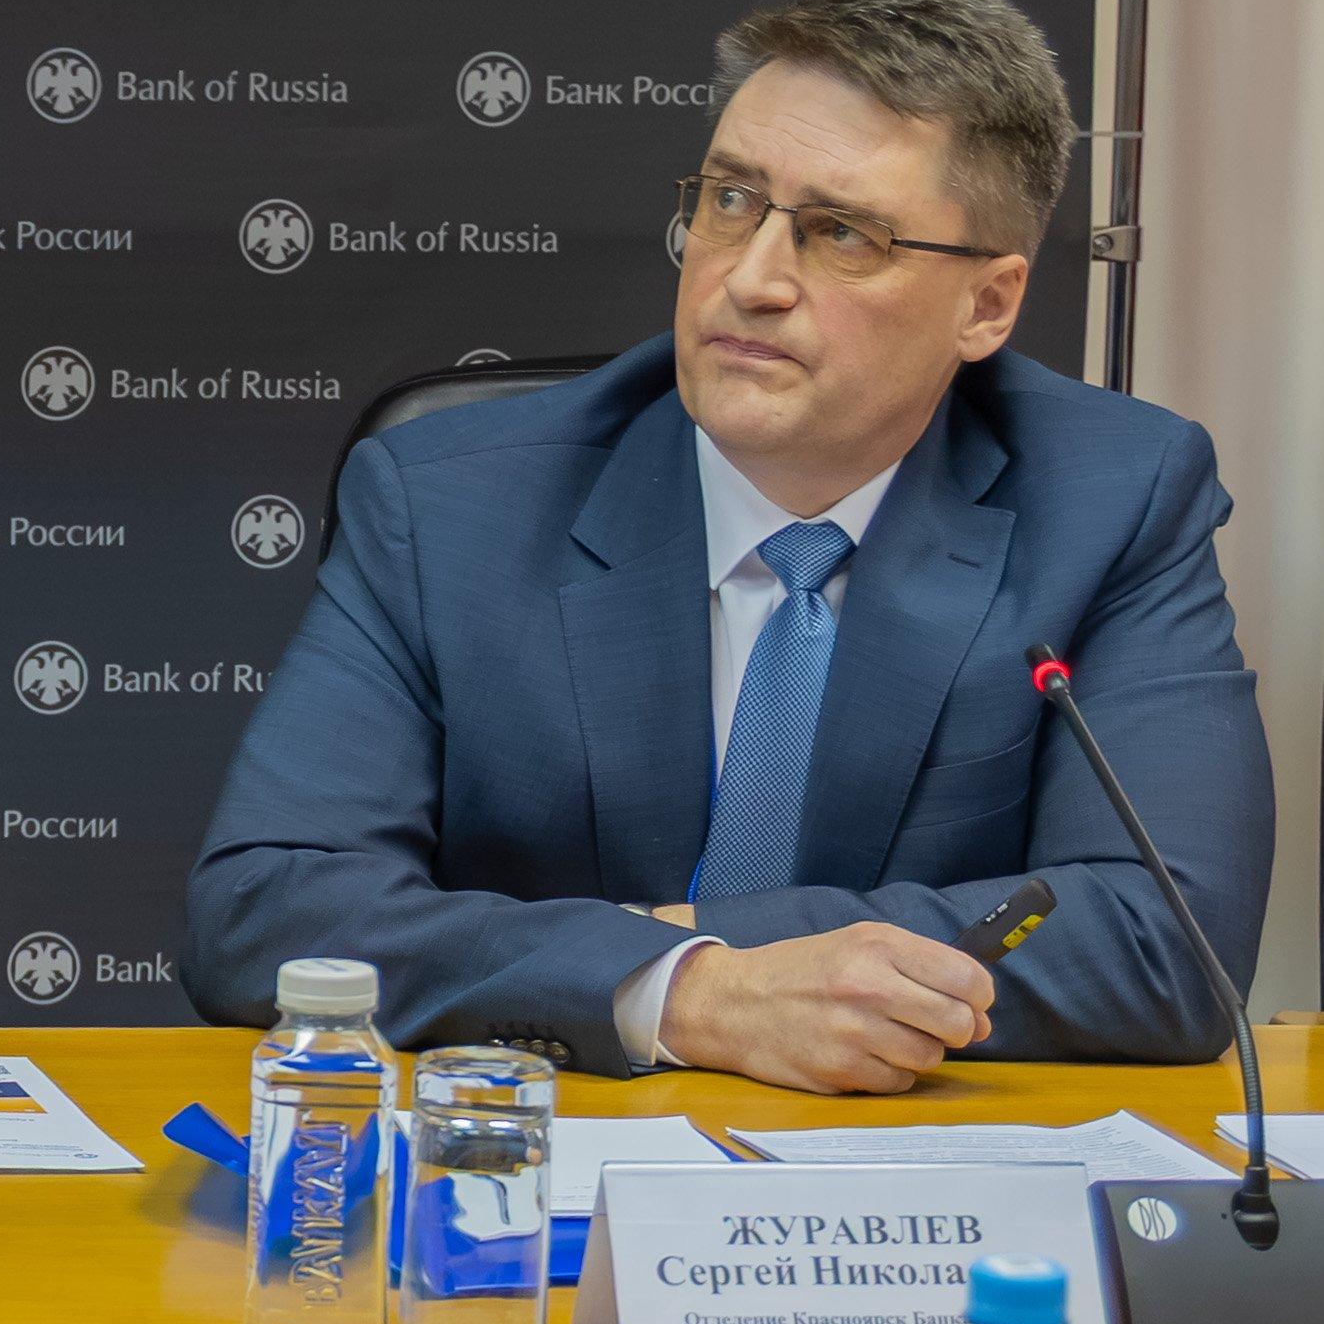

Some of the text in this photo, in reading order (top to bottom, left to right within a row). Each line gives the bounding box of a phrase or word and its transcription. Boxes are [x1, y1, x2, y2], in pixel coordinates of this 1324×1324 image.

[117, 69, 348, 103] Bank of Russia
[546, 75, 715, 106] Банк Росс
[17, 220, 132, 251] России
[329, 220, 559, 253] Bank of Russia
[111, 367, 341, 400] Bank of Russia
[10, 516, 126, 547] России
[104, 662, 181, 693] Bank
[190, 662, 225, 693] of
[3, 809, 118, 839] России
[96, 952, 173, 983] Bank
[721, 1215, 983, 1246] ЖУРАВЛЕВ
[656, 1254, 968, 1295] Сергей Никола
